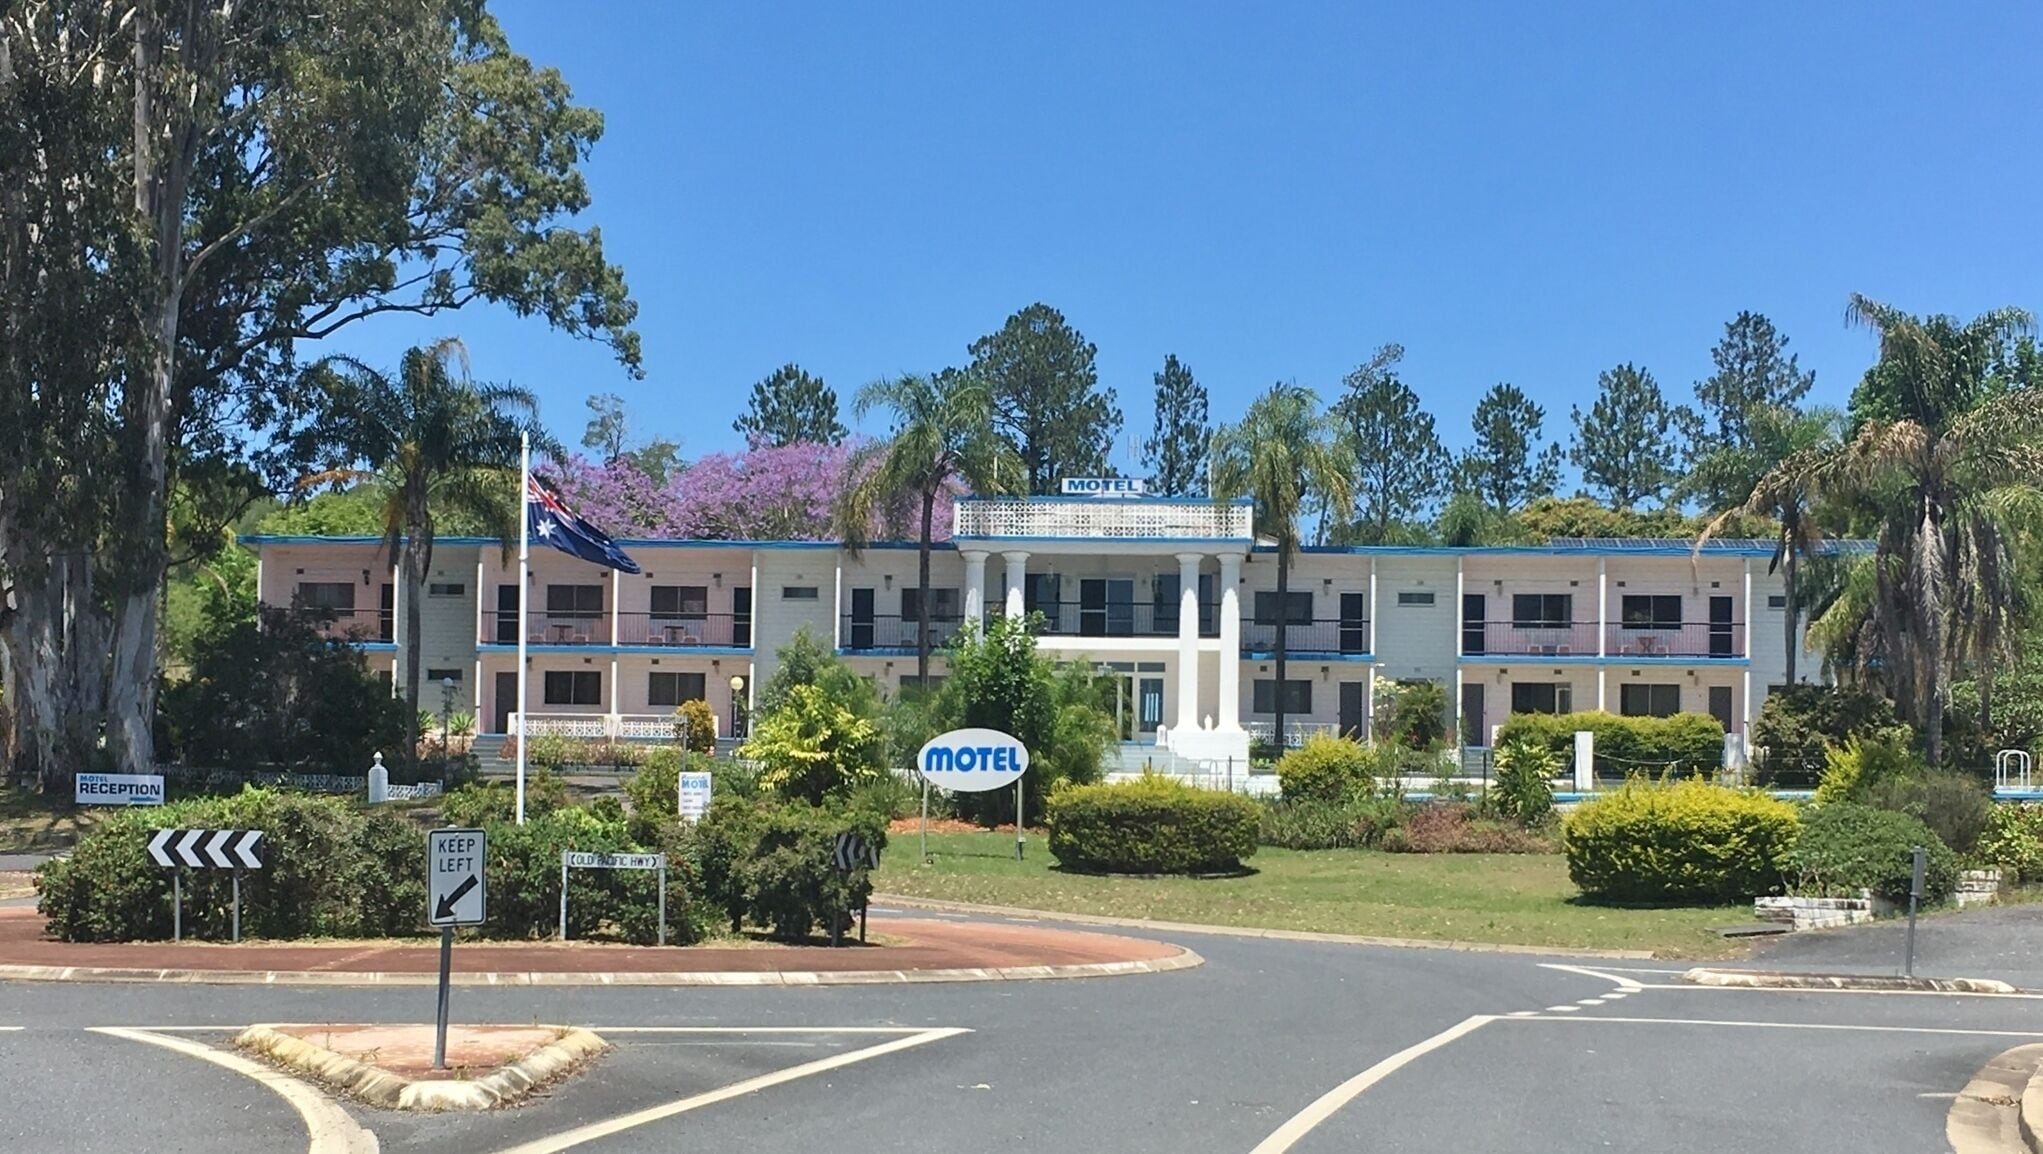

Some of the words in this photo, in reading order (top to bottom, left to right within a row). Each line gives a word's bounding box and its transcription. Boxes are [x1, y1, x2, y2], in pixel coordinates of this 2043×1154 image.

[1068, 480, 1138, 491] MOTEL
[925, 746, 1021, 772] MOTEL
[80, 783, 160, 795] RECEPTION
[438, 838, 475, 853] KEEP
[439, 857, 473, 872] LEFT
